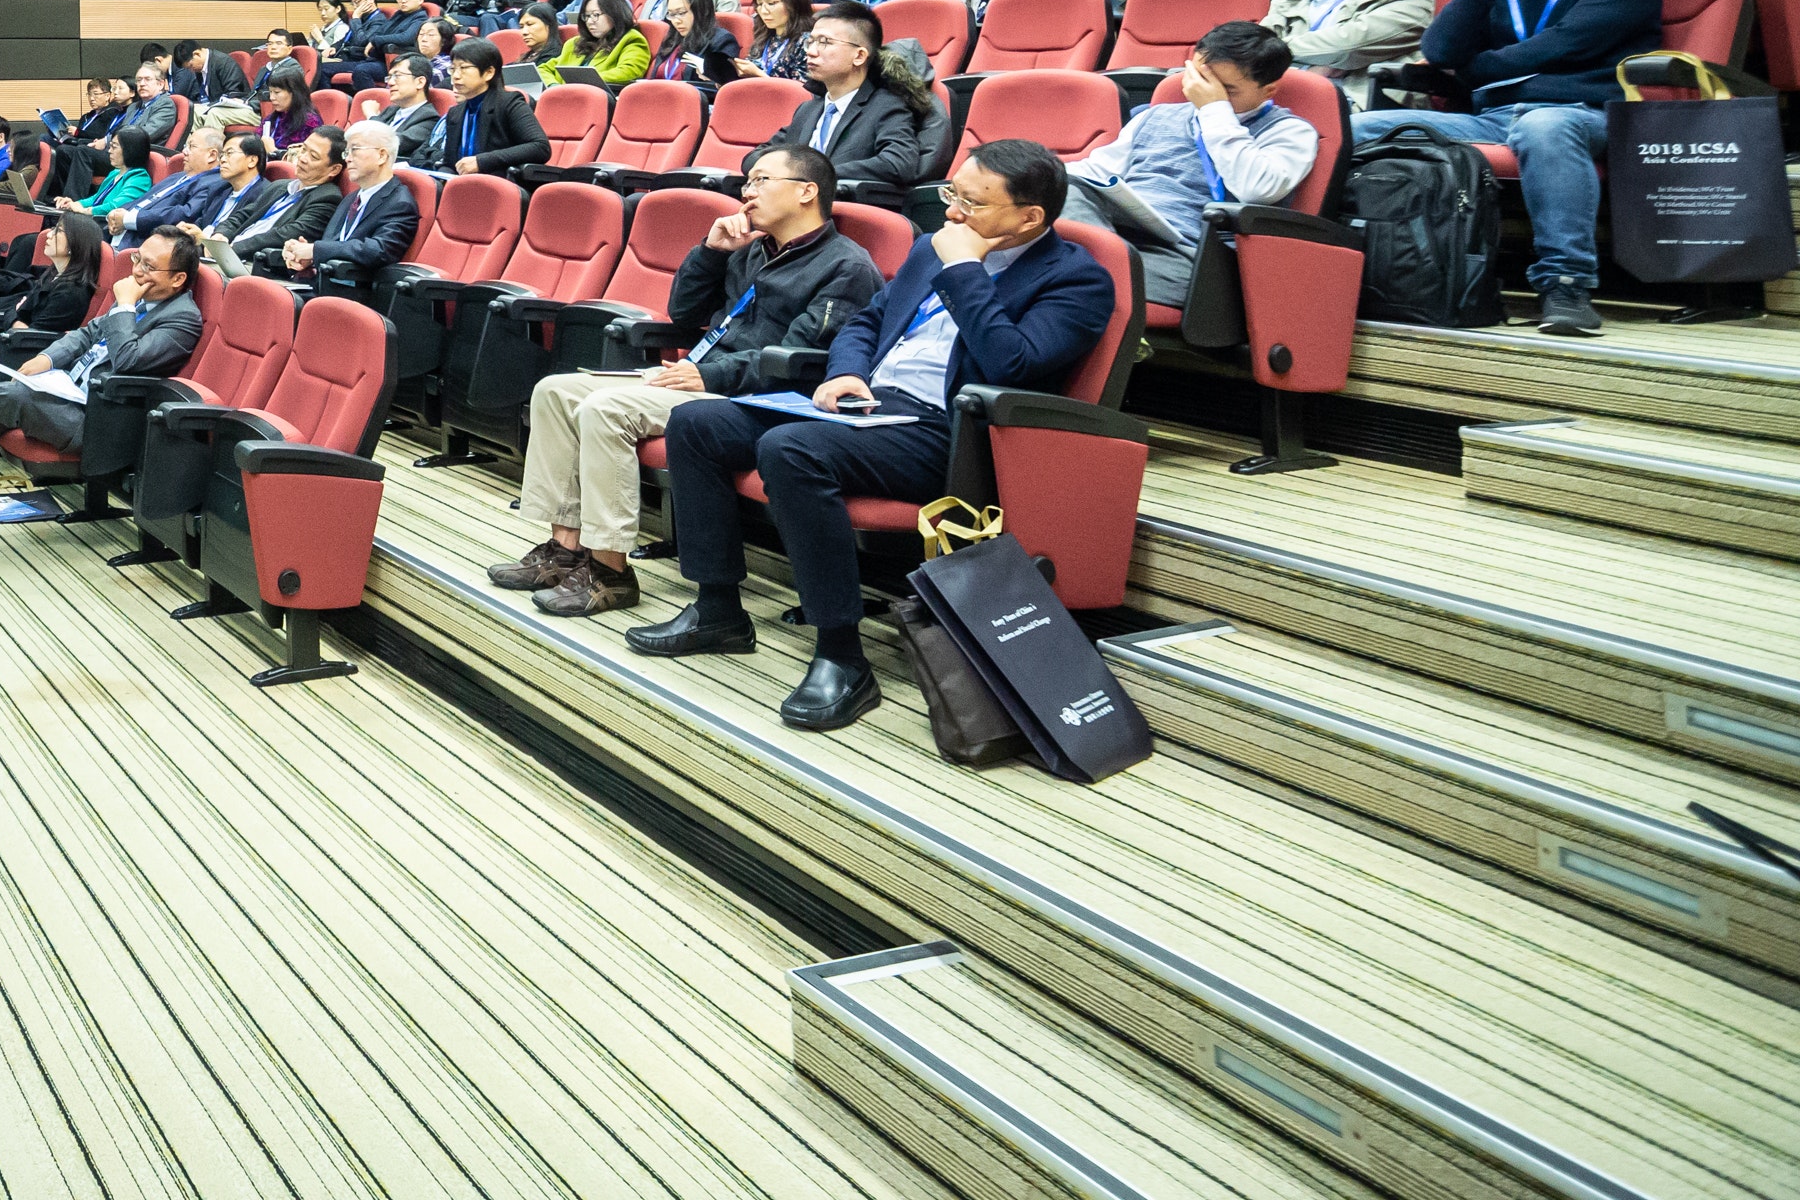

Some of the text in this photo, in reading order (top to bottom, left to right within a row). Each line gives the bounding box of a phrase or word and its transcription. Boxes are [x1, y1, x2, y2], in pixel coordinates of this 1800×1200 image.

[1638, 142, 1741, 155] 2018 ICSA
[1670, 156, 1738, 164] Conference
